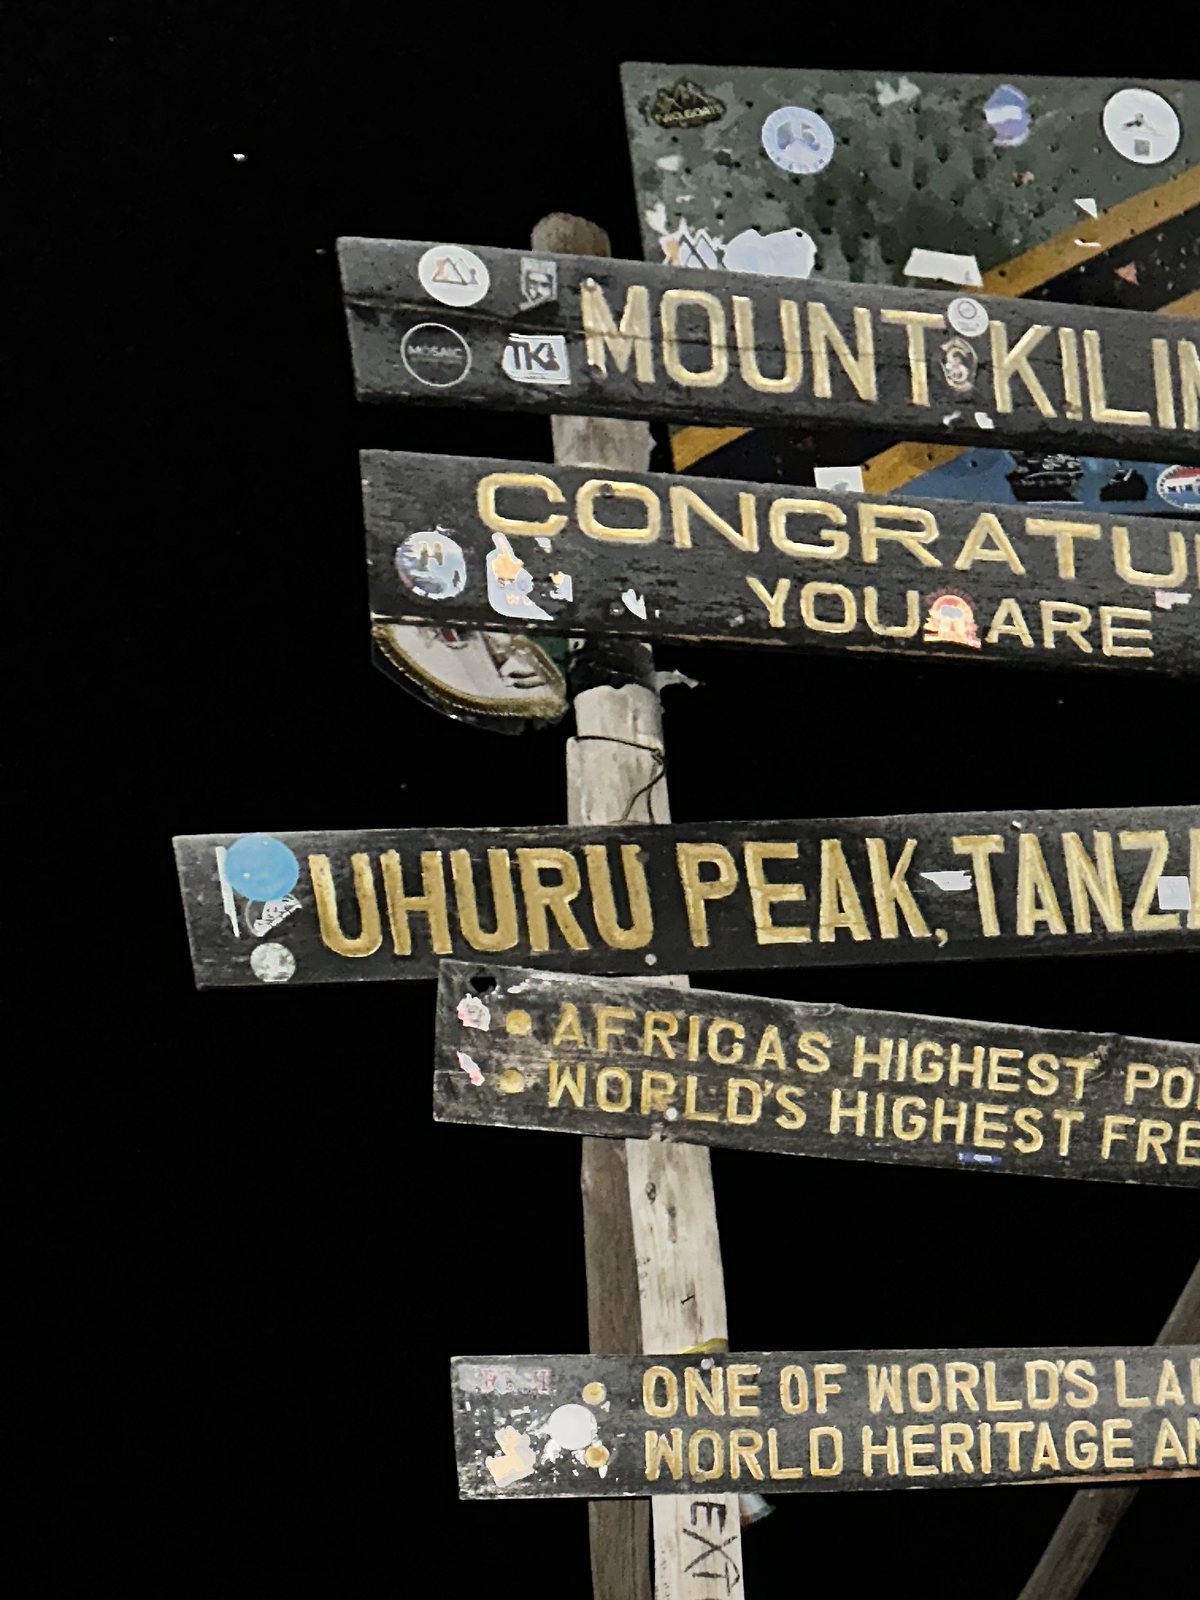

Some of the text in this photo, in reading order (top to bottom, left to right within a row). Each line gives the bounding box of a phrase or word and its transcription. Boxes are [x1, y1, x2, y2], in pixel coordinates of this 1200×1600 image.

[580, 277, 943, 408] MOUNT
[747, 577, 921, 640] YOU
[985, 597, 1154, 659] ARE
[307, 843, 655, 958] UHURU
[552, 1002, 832, 1075] AFRICAS
[853, 1036, 1100, 1102] HIGHEST
[547, 1060, 808, 1131] WORLD'S
[829, 1086, 1085, 1157] HIGHEST
[641, 1363, 761, 1419] ONE
[779, 1363, 847, 1415] OF
[866, 1359, 1099, 1415] WORLD'S
[644, 1426, 843, 1481] WORLD
[862, 1419, 1136, 1477] HERITAGE
